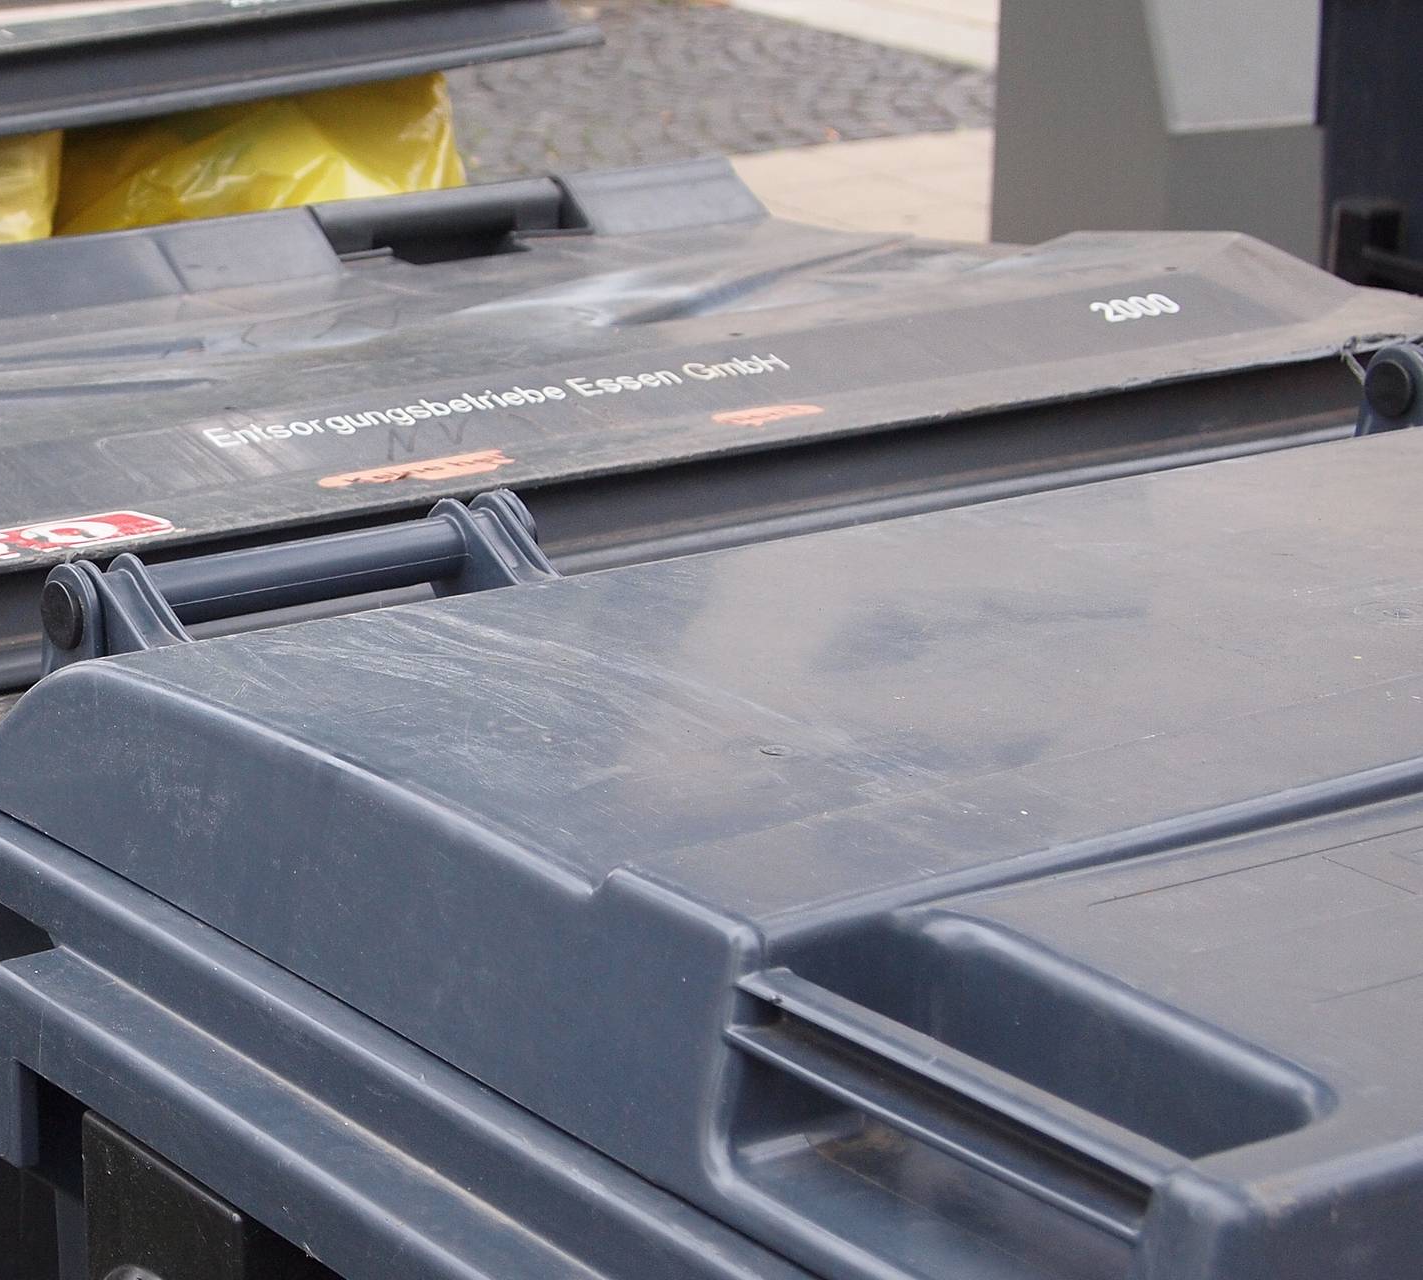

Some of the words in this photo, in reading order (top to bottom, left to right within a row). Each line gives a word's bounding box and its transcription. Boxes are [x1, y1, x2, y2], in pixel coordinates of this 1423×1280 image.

[1089, 293, 1181, 323] 2000
[203, 385, 567, 449] Entsorgungsbetriebe
[564, 366, 683, 398] Essen
[682, 352, 791, 382] GmbH
